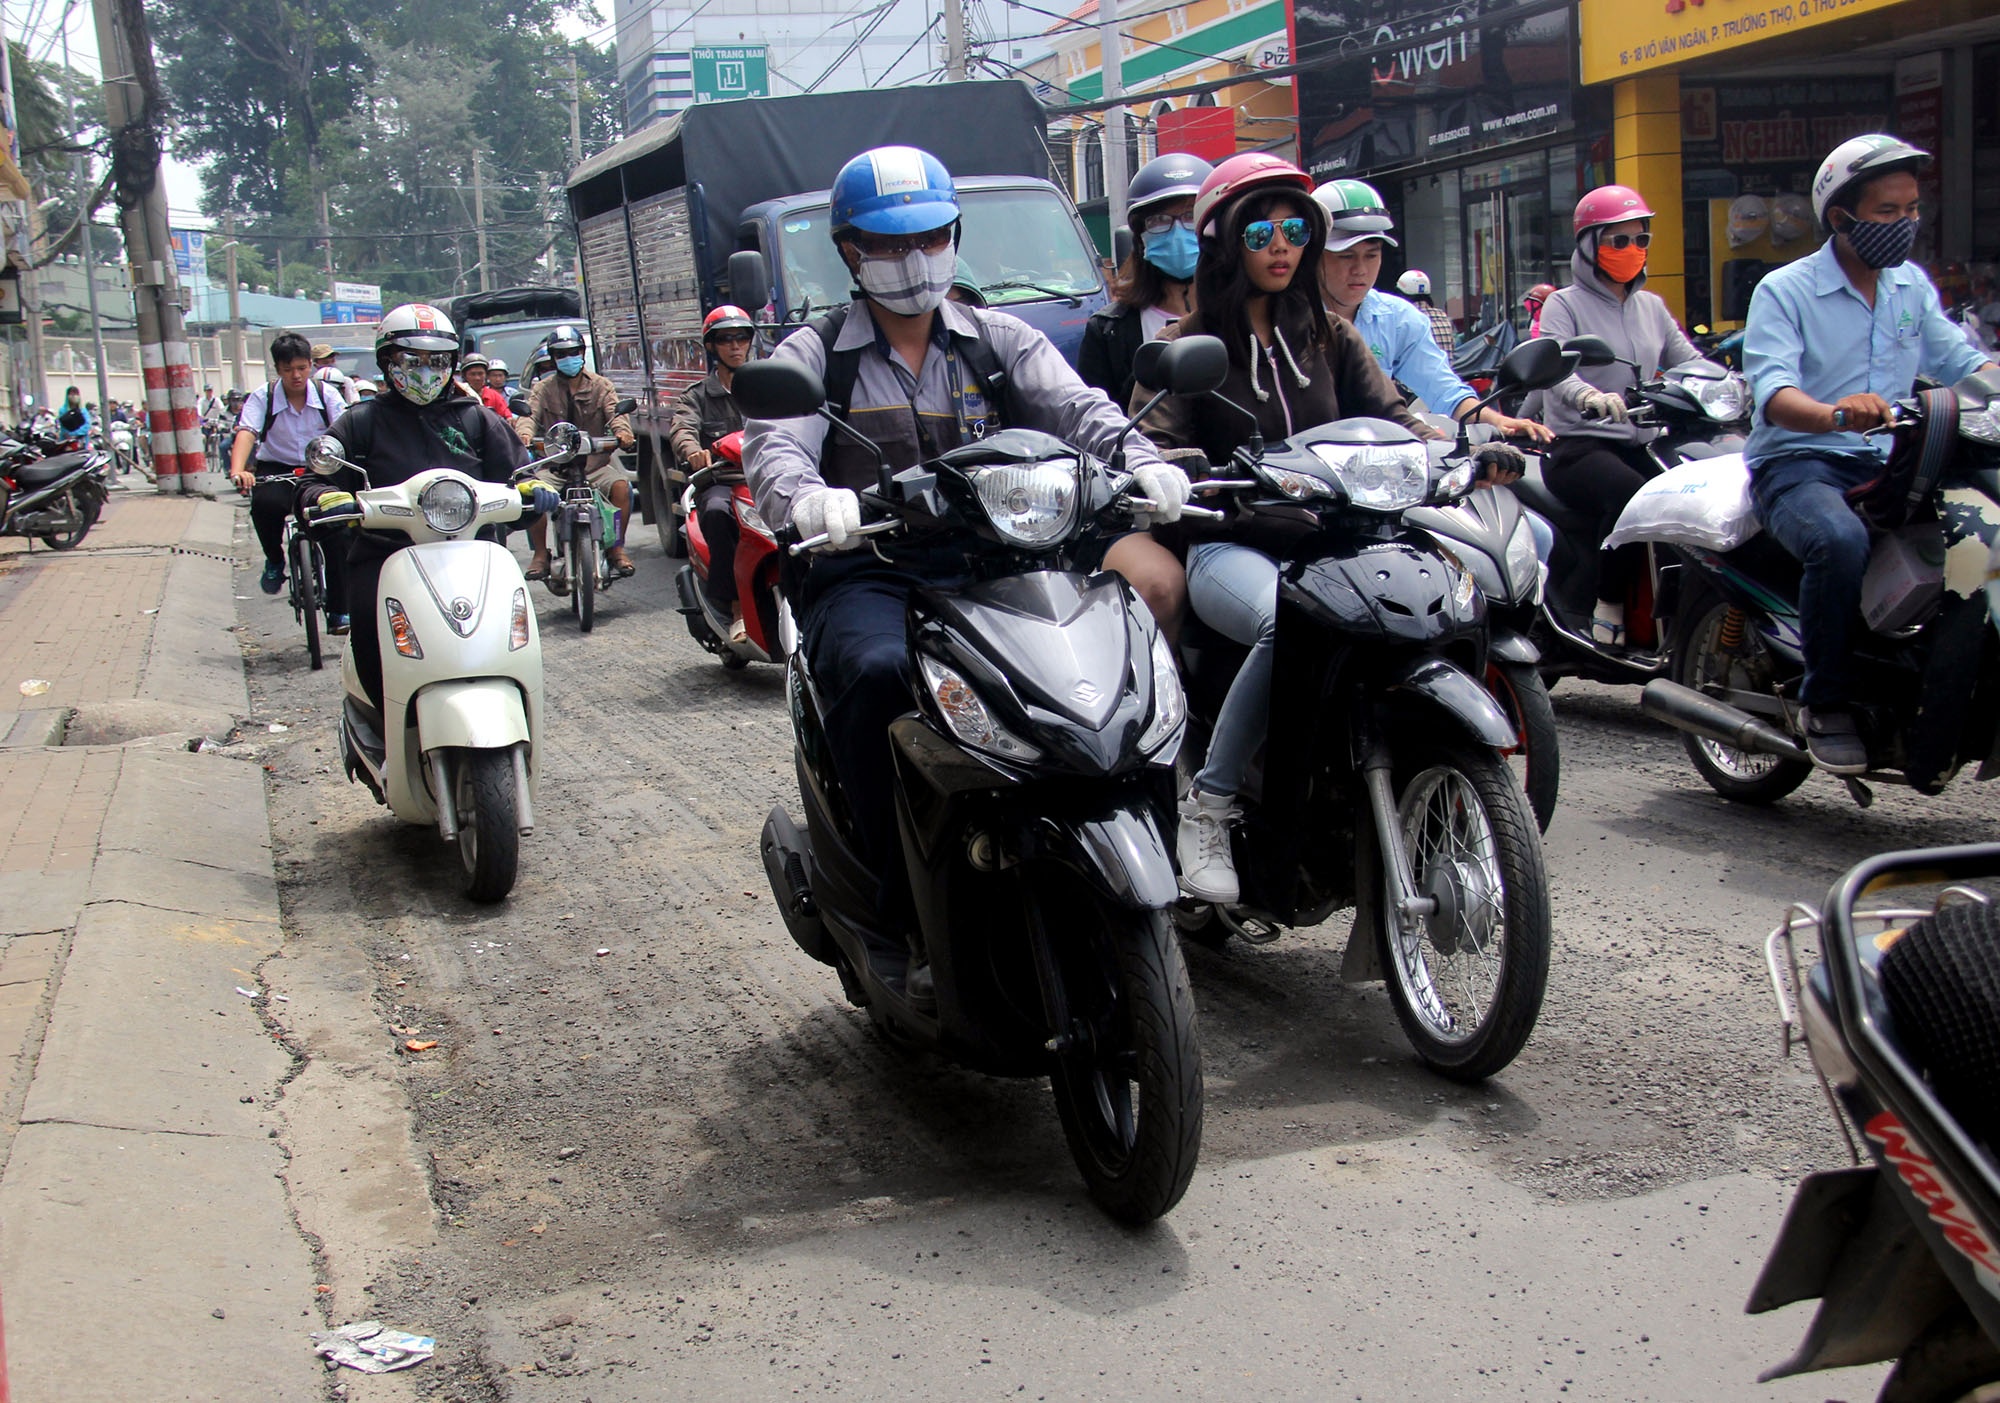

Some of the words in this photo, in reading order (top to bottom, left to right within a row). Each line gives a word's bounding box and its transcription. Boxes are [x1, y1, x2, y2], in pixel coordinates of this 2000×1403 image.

[1619, 50, 1628, 66] 16
[1711, 26, 1720, 41] P.
[1799, 1, 1810, 17] Q.
[716, 50, 744, 59] TRANG
[746, 49, 764, 58] NAM
[1482, 104, 1558, 132] www.owen.com.vn
[1366, 543, 1415, 551] HONDA
[1864, 1110, 2000, 1275] Wave
